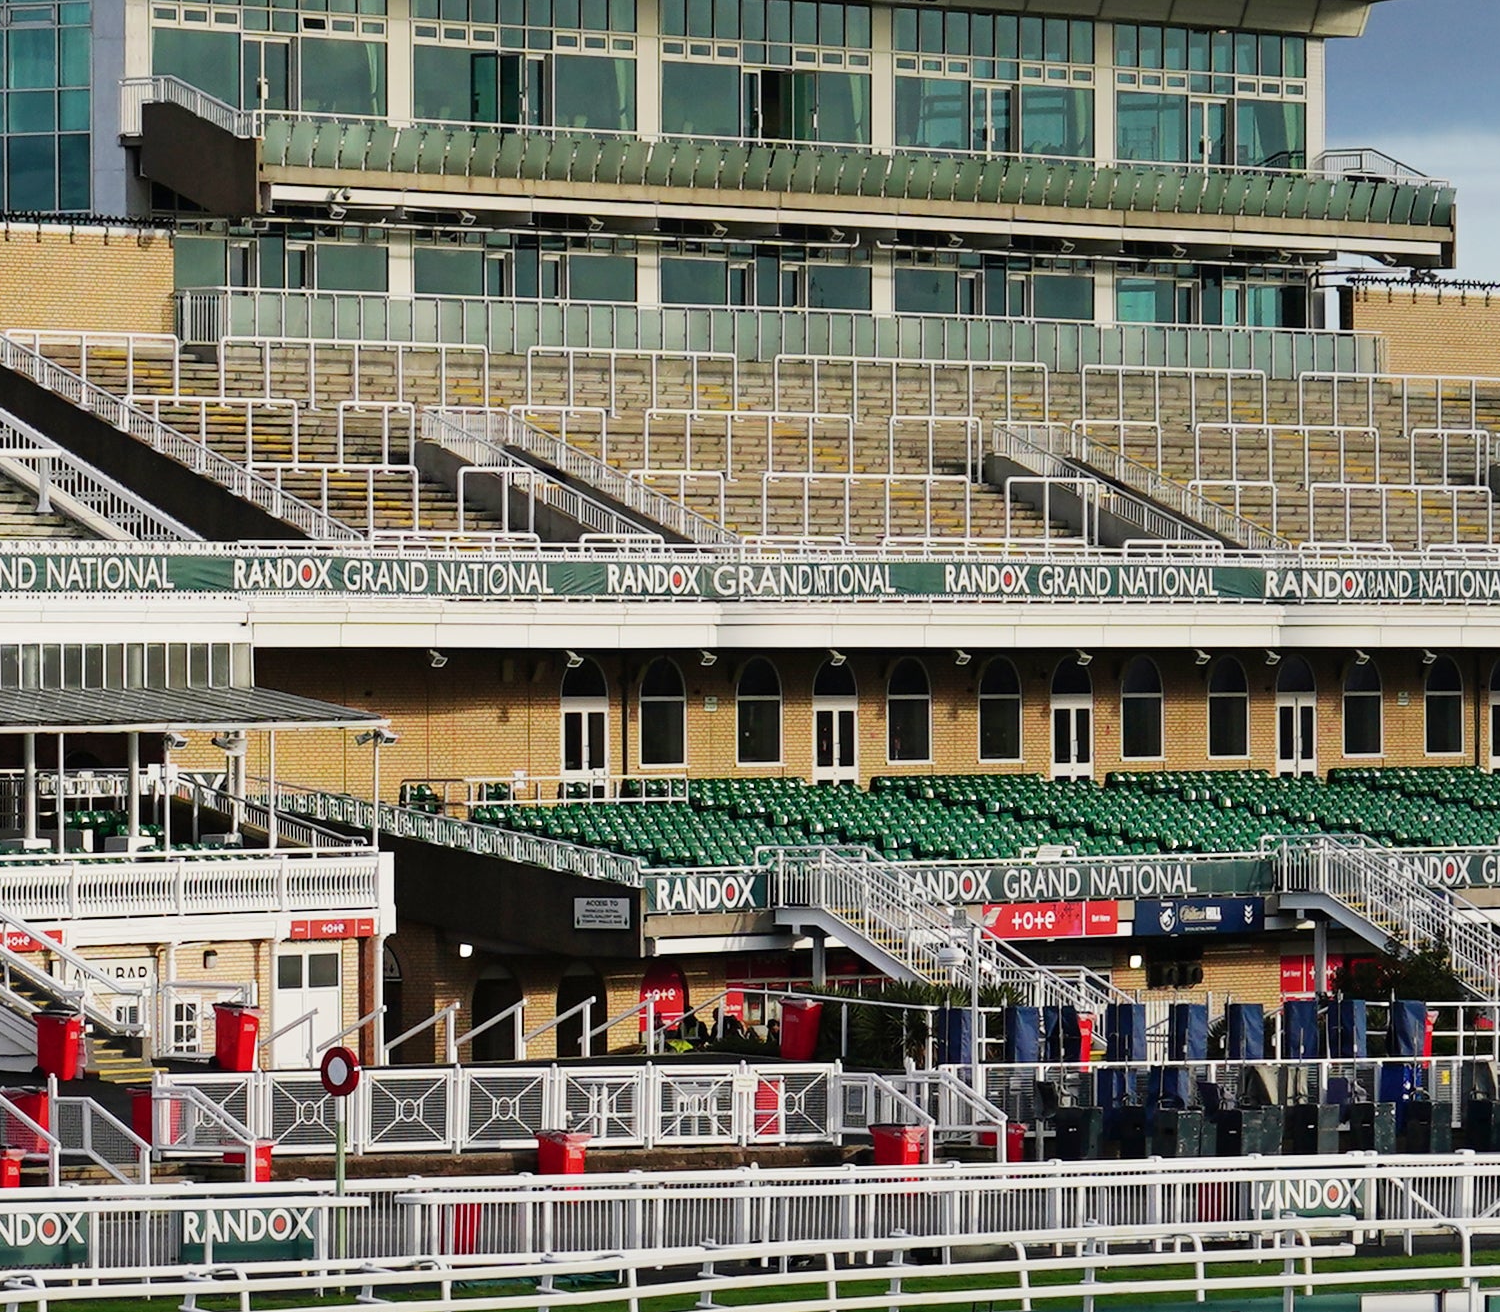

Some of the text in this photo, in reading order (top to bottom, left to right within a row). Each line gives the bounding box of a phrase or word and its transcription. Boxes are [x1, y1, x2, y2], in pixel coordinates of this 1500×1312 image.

[46, 557, 175, 590] NATIONAL
[233, 558, 555, 595] RANDOX GRAND NATIONAL
[606, 563, 700, 595] RANDOX
[945, 564, 1219, 597] RANDOX GRAND NATIONAL
[1264, 569, 1367, 598] RANDOX
[656, 877, 758, 911] RANDOX
[1003, 867, 1081, 899] GRAND
[1089, 864, 1198, 897] NATIONAL
[1011, 909, 1056, 930] tote
[183, 1208, 315, 1245] RANDOX
